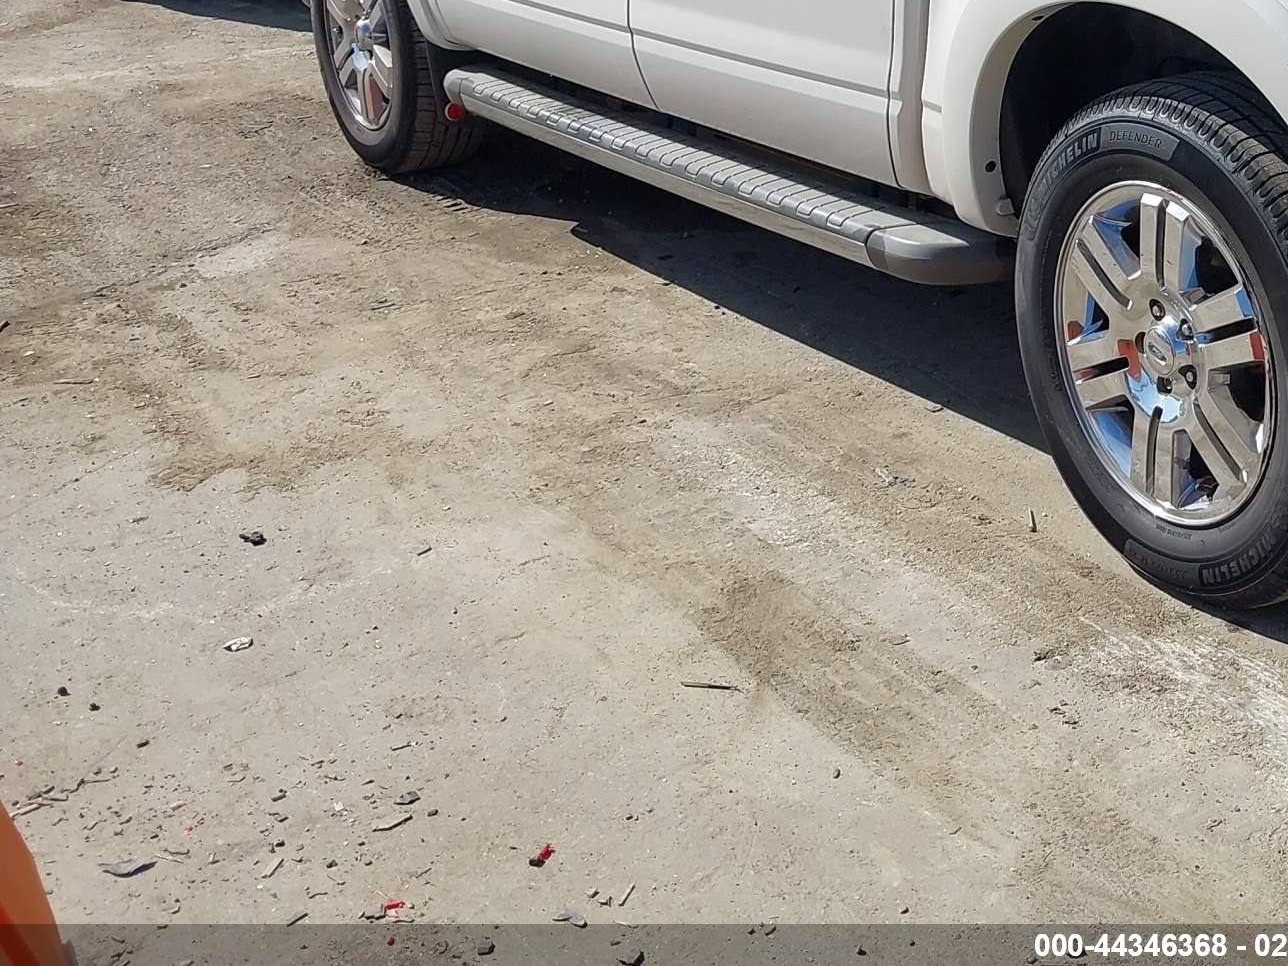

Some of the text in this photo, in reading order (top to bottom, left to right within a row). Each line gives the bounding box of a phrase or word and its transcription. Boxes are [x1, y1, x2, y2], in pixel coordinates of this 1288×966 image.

[1037, 130, 1162, 194] MICHELIN DEFENDER
[1202, 530, 1277, 584] MICHELIN
